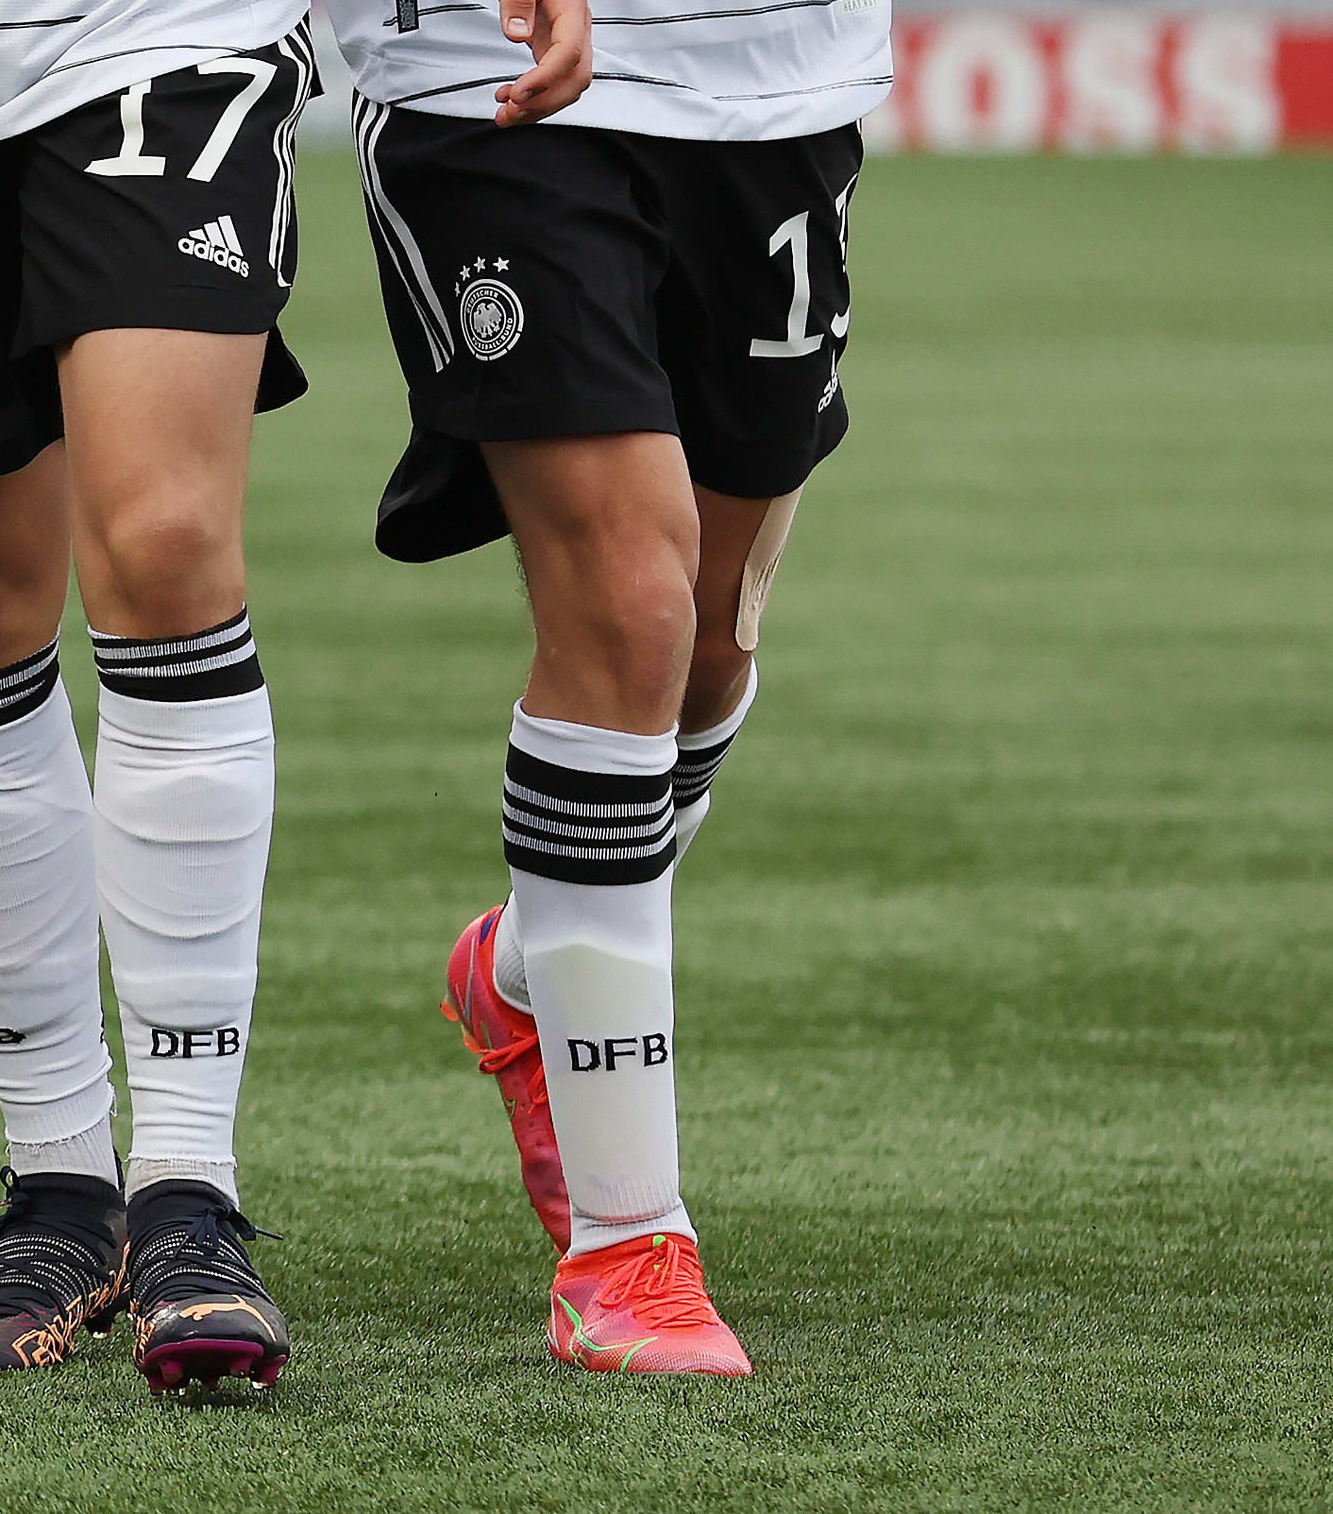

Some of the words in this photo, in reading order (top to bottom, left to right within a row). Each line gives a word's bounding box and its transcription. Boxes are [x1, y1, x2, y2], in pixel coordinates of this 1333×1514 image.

[861, 12, 1283, 154] OSS
[83, 57, 278, 183] 17
[177, 236, 249, 278] adidas
[150, 1026, 241, 1059] DFB
[569, 1032, 668, 1072] DFB
